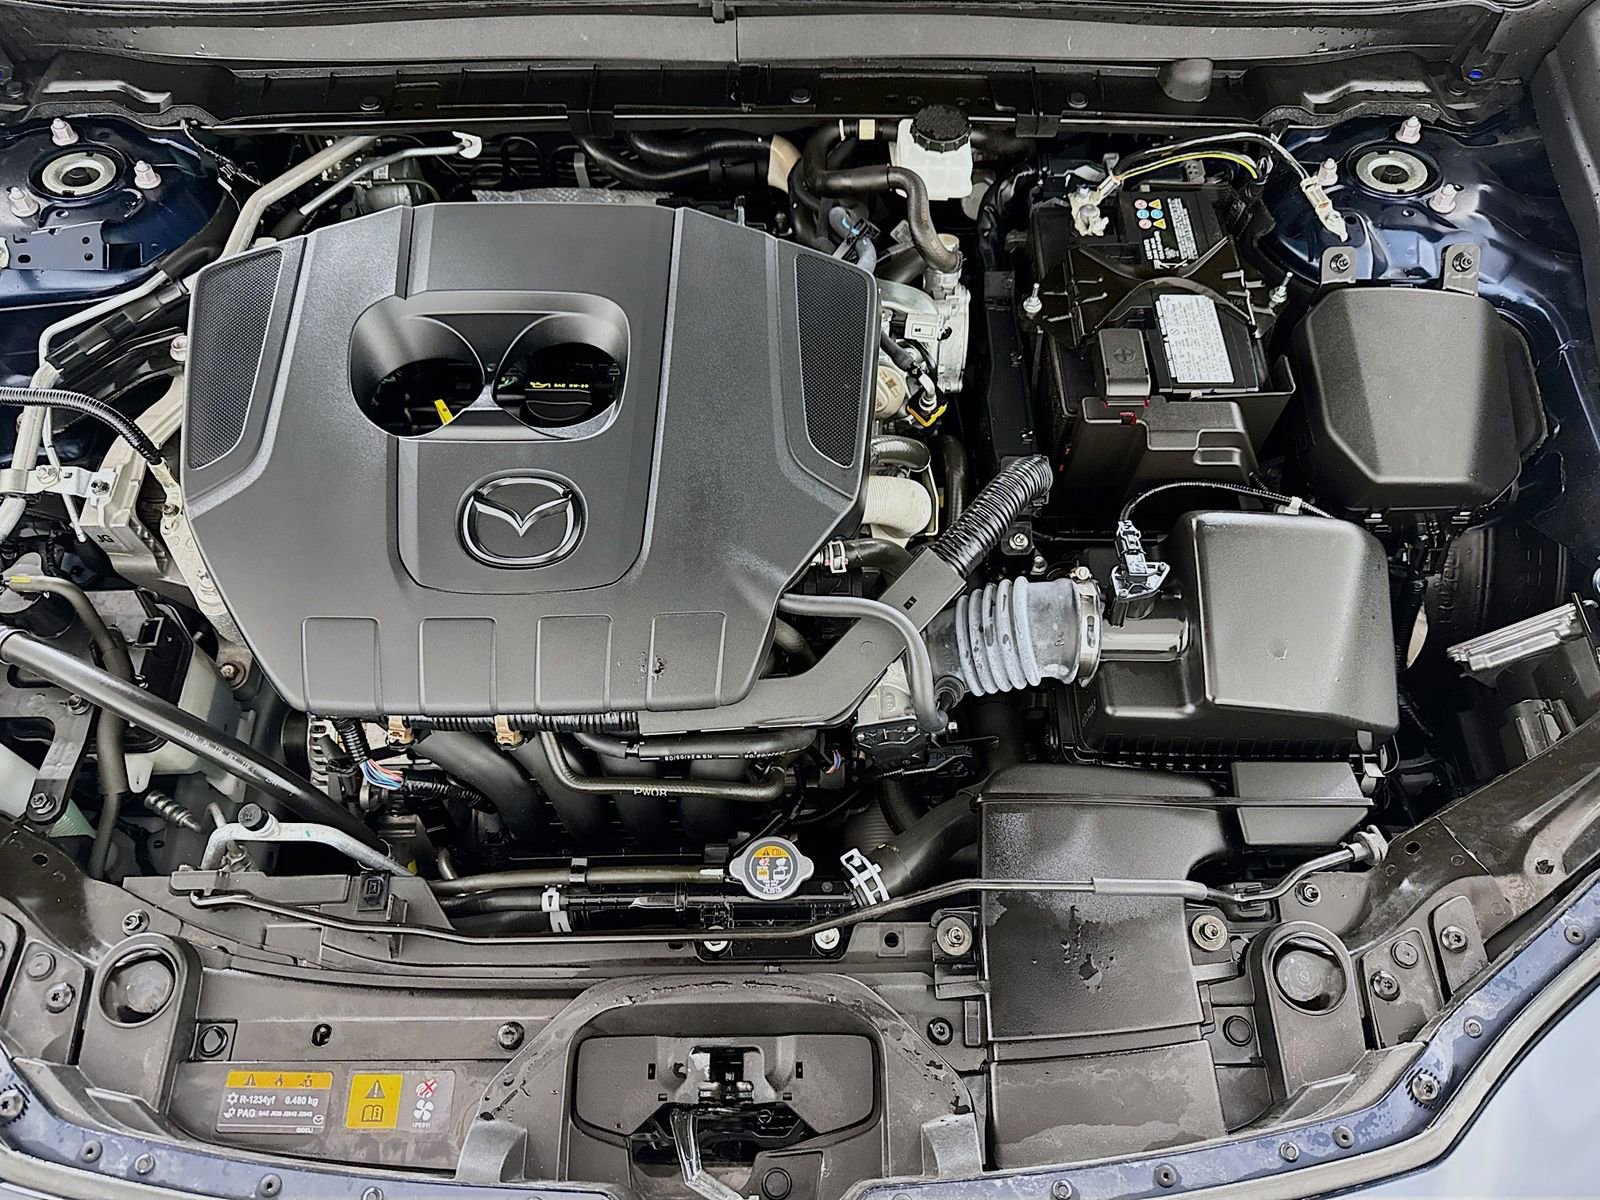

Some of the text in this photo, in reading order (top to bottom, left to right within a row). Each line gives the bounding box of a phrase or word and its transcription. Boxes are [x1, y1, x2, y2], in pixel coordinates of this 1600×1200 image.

[97, 534, 115, 543] JG
[239, 1095, 319, 1107] R-1234yf 0.480 kg
[237, 1108, 256, 1117] PAG
